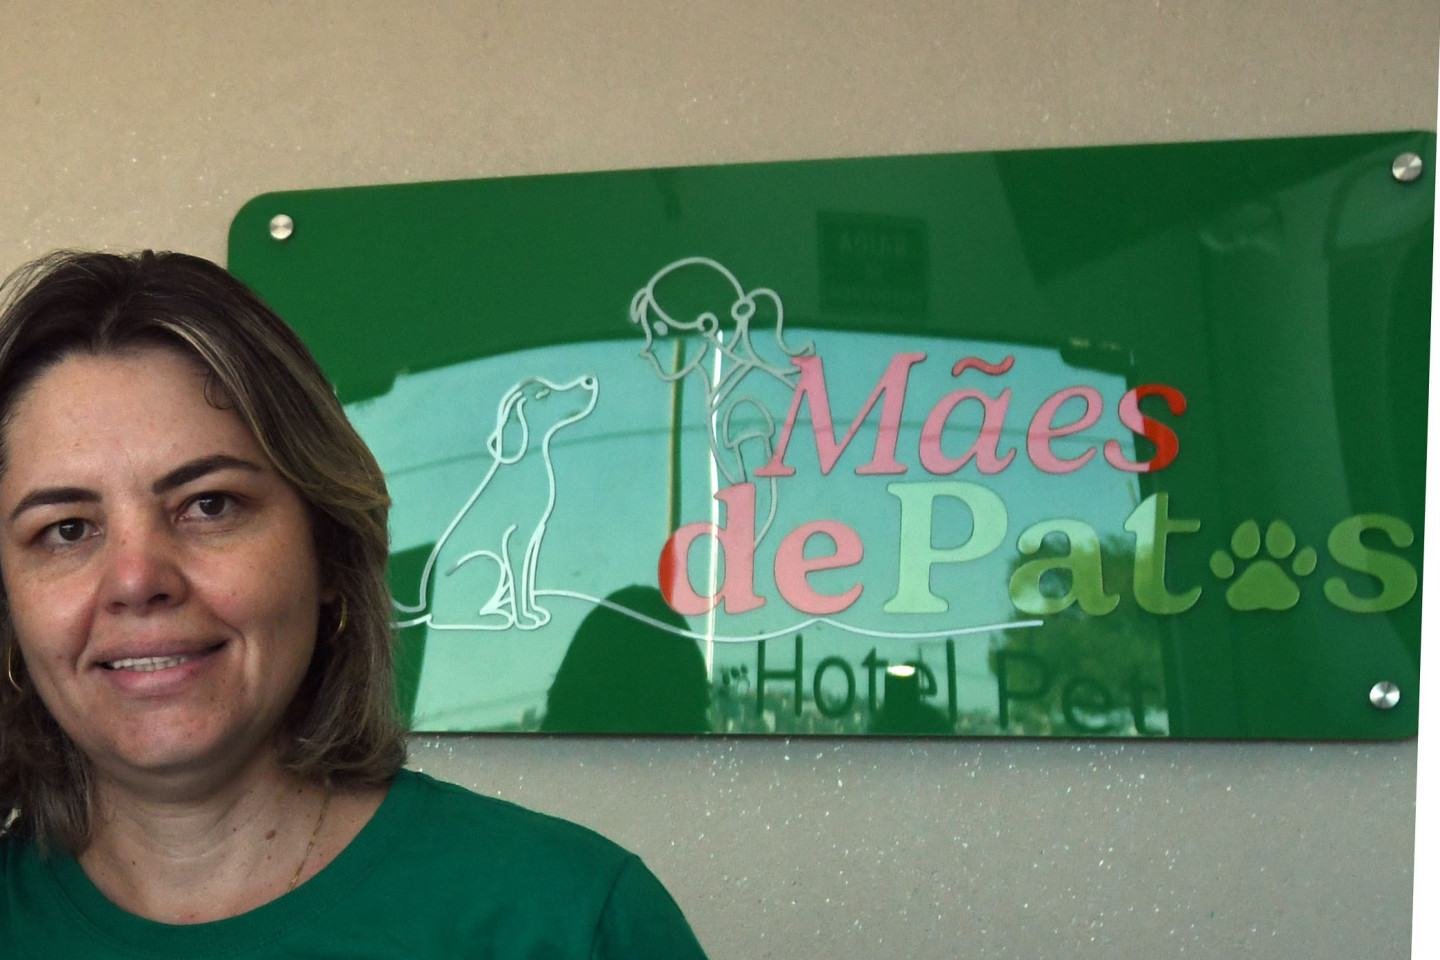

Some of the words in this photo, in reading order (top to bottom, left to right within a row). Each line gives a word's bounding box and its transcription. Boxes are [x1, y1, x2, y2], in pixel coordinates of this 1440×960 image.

[754, 351, 1188, 478] Mães
[757, 634, 958, 724] Hotel
[997, 647, 1169, 735] Pet
